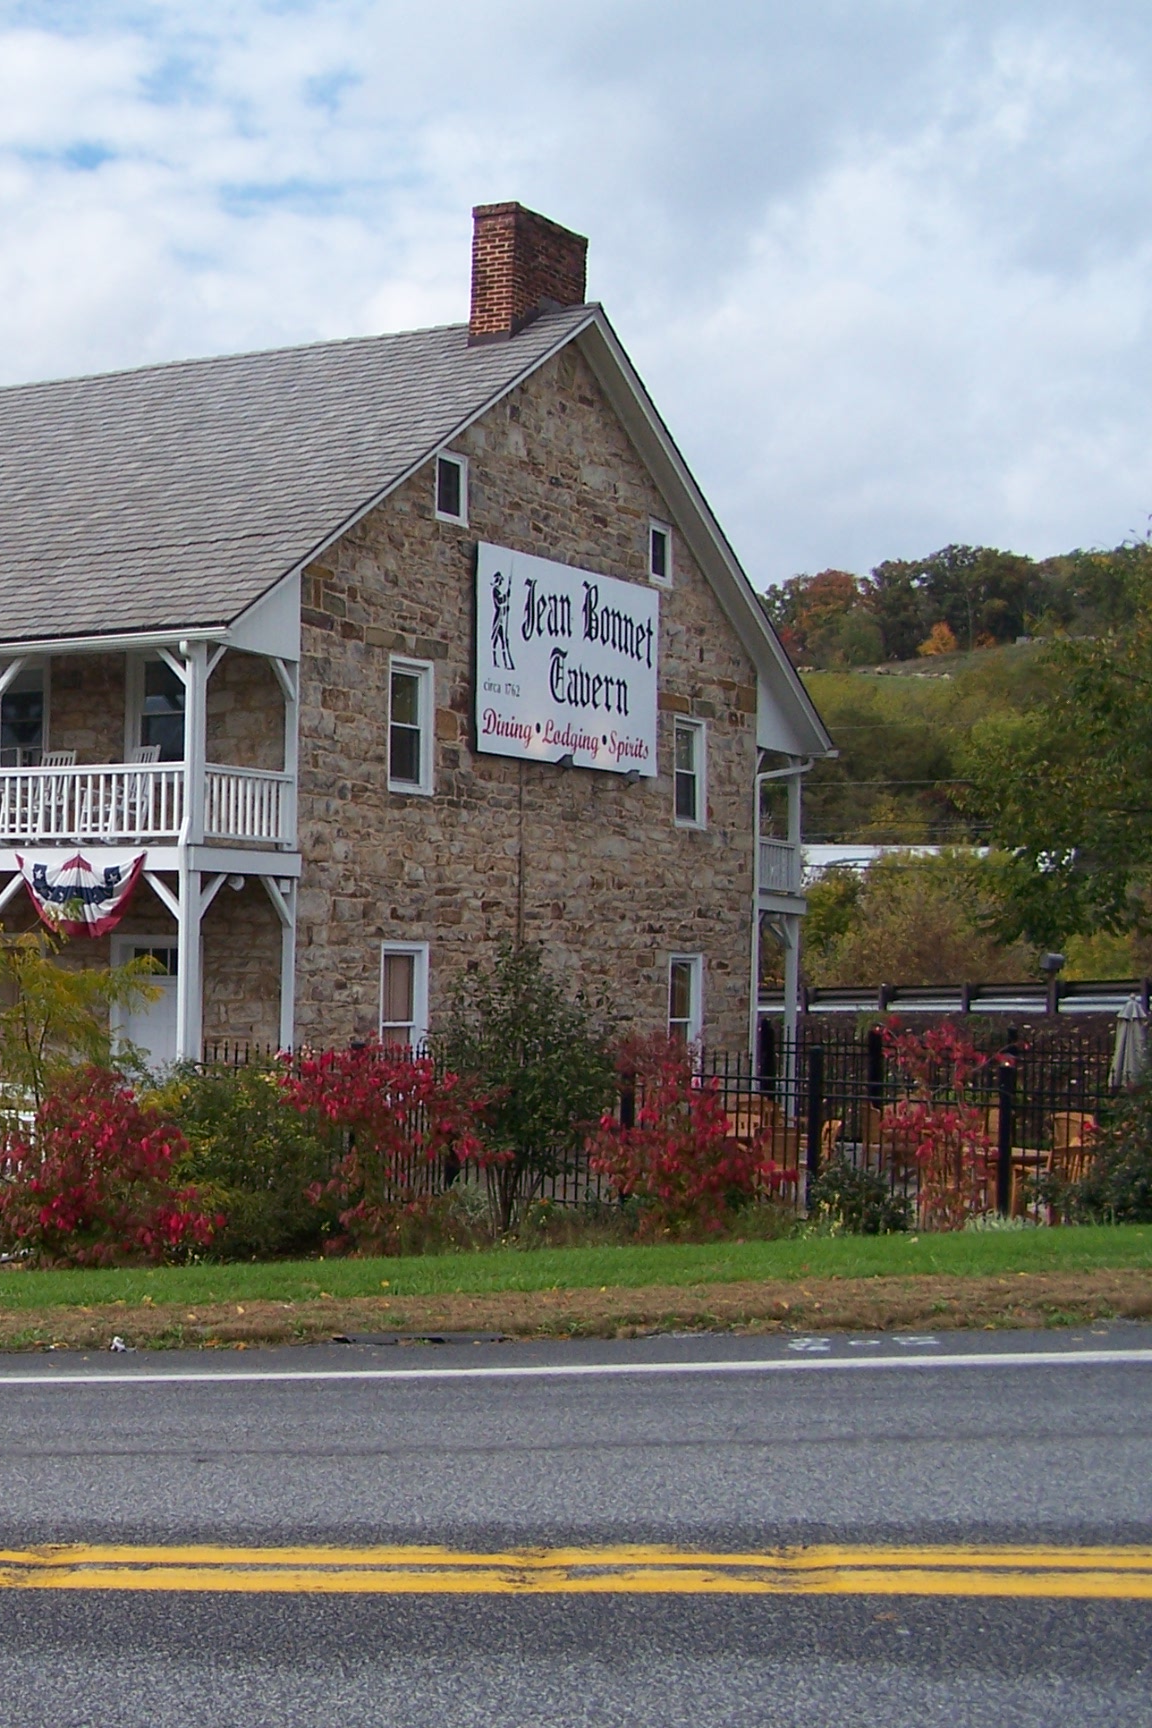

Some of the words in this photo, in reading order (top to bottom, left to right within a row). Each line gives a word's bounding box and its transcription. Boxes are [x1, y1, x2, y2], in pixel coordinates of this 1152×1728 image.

[521, 578, 572, 642] Jean
[582, 580, 654, 669] Bonnet
[483, 677, 501, 694] circa
[549, 647, 629, 716] Tavern
[482, 708, 533, 749] Dining
[542, 719, 599, 759] Lodging
[608, 730, 649, 762] Spirits
